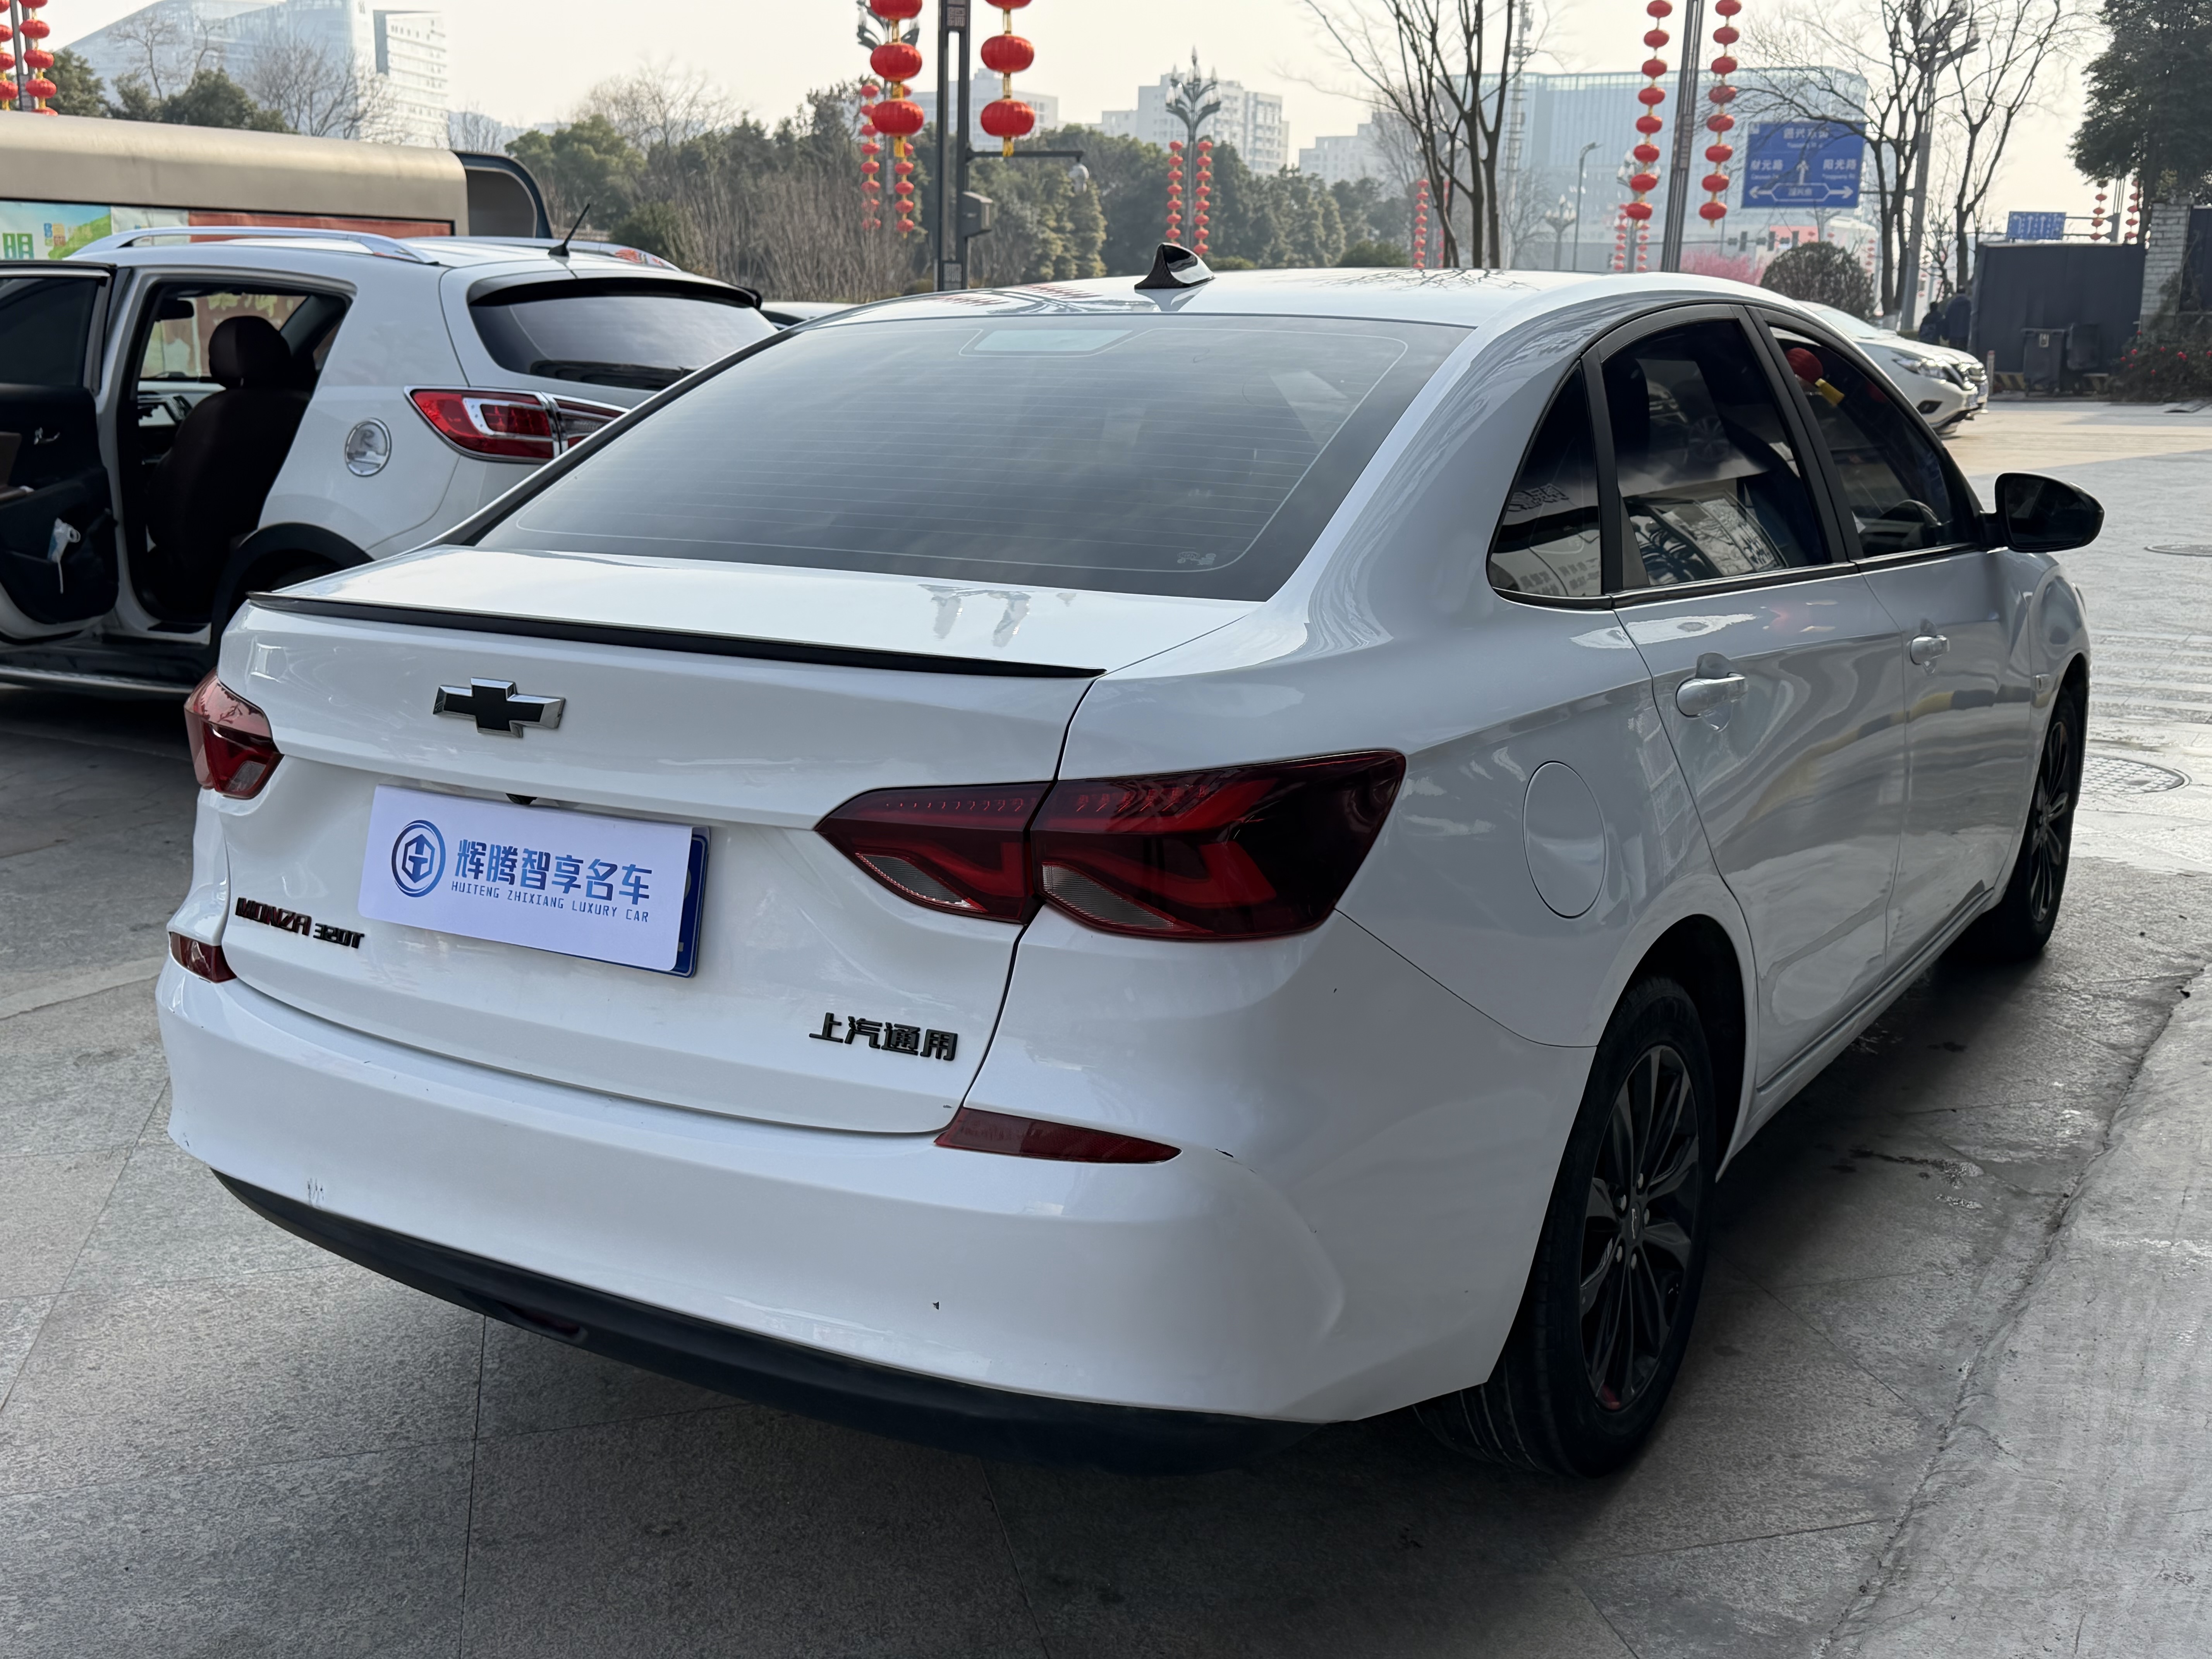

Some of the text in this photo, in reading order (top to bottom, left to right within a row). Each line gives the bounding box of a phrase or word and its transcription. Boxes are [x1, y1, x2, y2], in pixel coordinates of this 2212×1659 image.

[454, 839, 653, 905] 辉腾智享名车
[235, 897, 365, 949] MONZA 320T
[452, 881, 649, 922] HUITENG ZHIXIANG LUXURY CAR
[809, 1012, 958, 1061] 上汽通用
